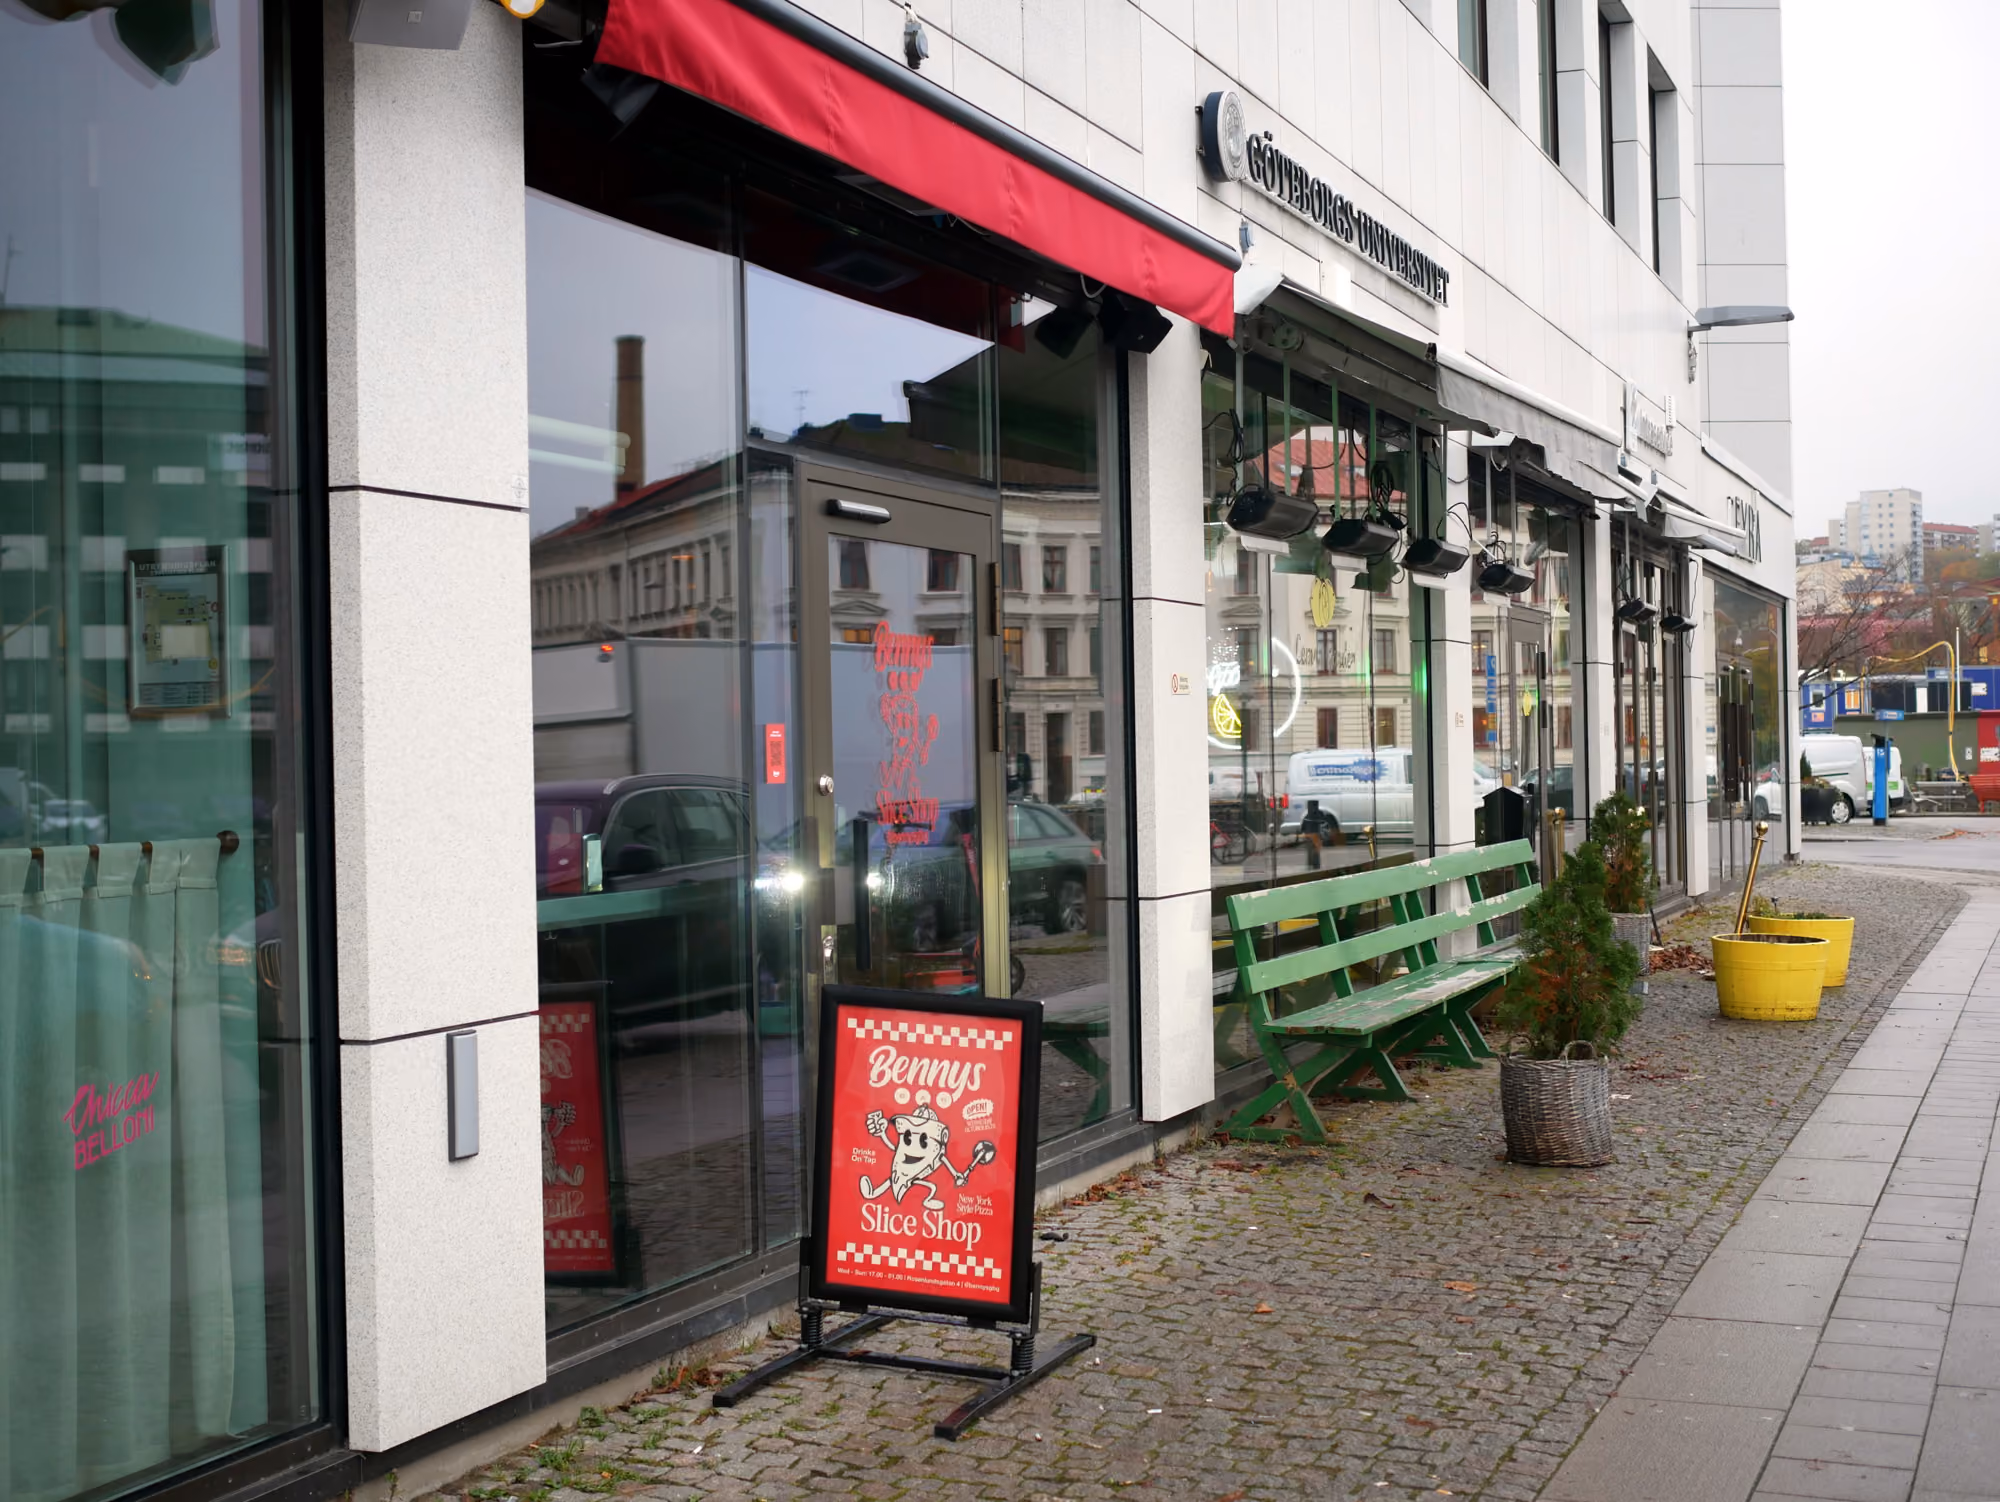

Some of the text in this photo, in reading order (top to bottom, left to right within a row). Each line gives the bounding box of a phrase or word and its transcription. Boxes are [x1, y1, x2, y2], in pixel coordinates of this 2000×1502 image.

[1247, 130, 1450, 305] GÖTEBORGS UNIVERSITET
[868, 1045, 986, 1103] Bennys
[966, 1102, 988, 1115] OPEN!
[852, 1147, 876, 1156] Drinks
[863, 1156, 877, 1165] Tap
[958, 1193, 993, 1206] New York
[956, 1202, 994, 1216] Style Pizza
[861, 1202, 982, 1251] Slice Shop
